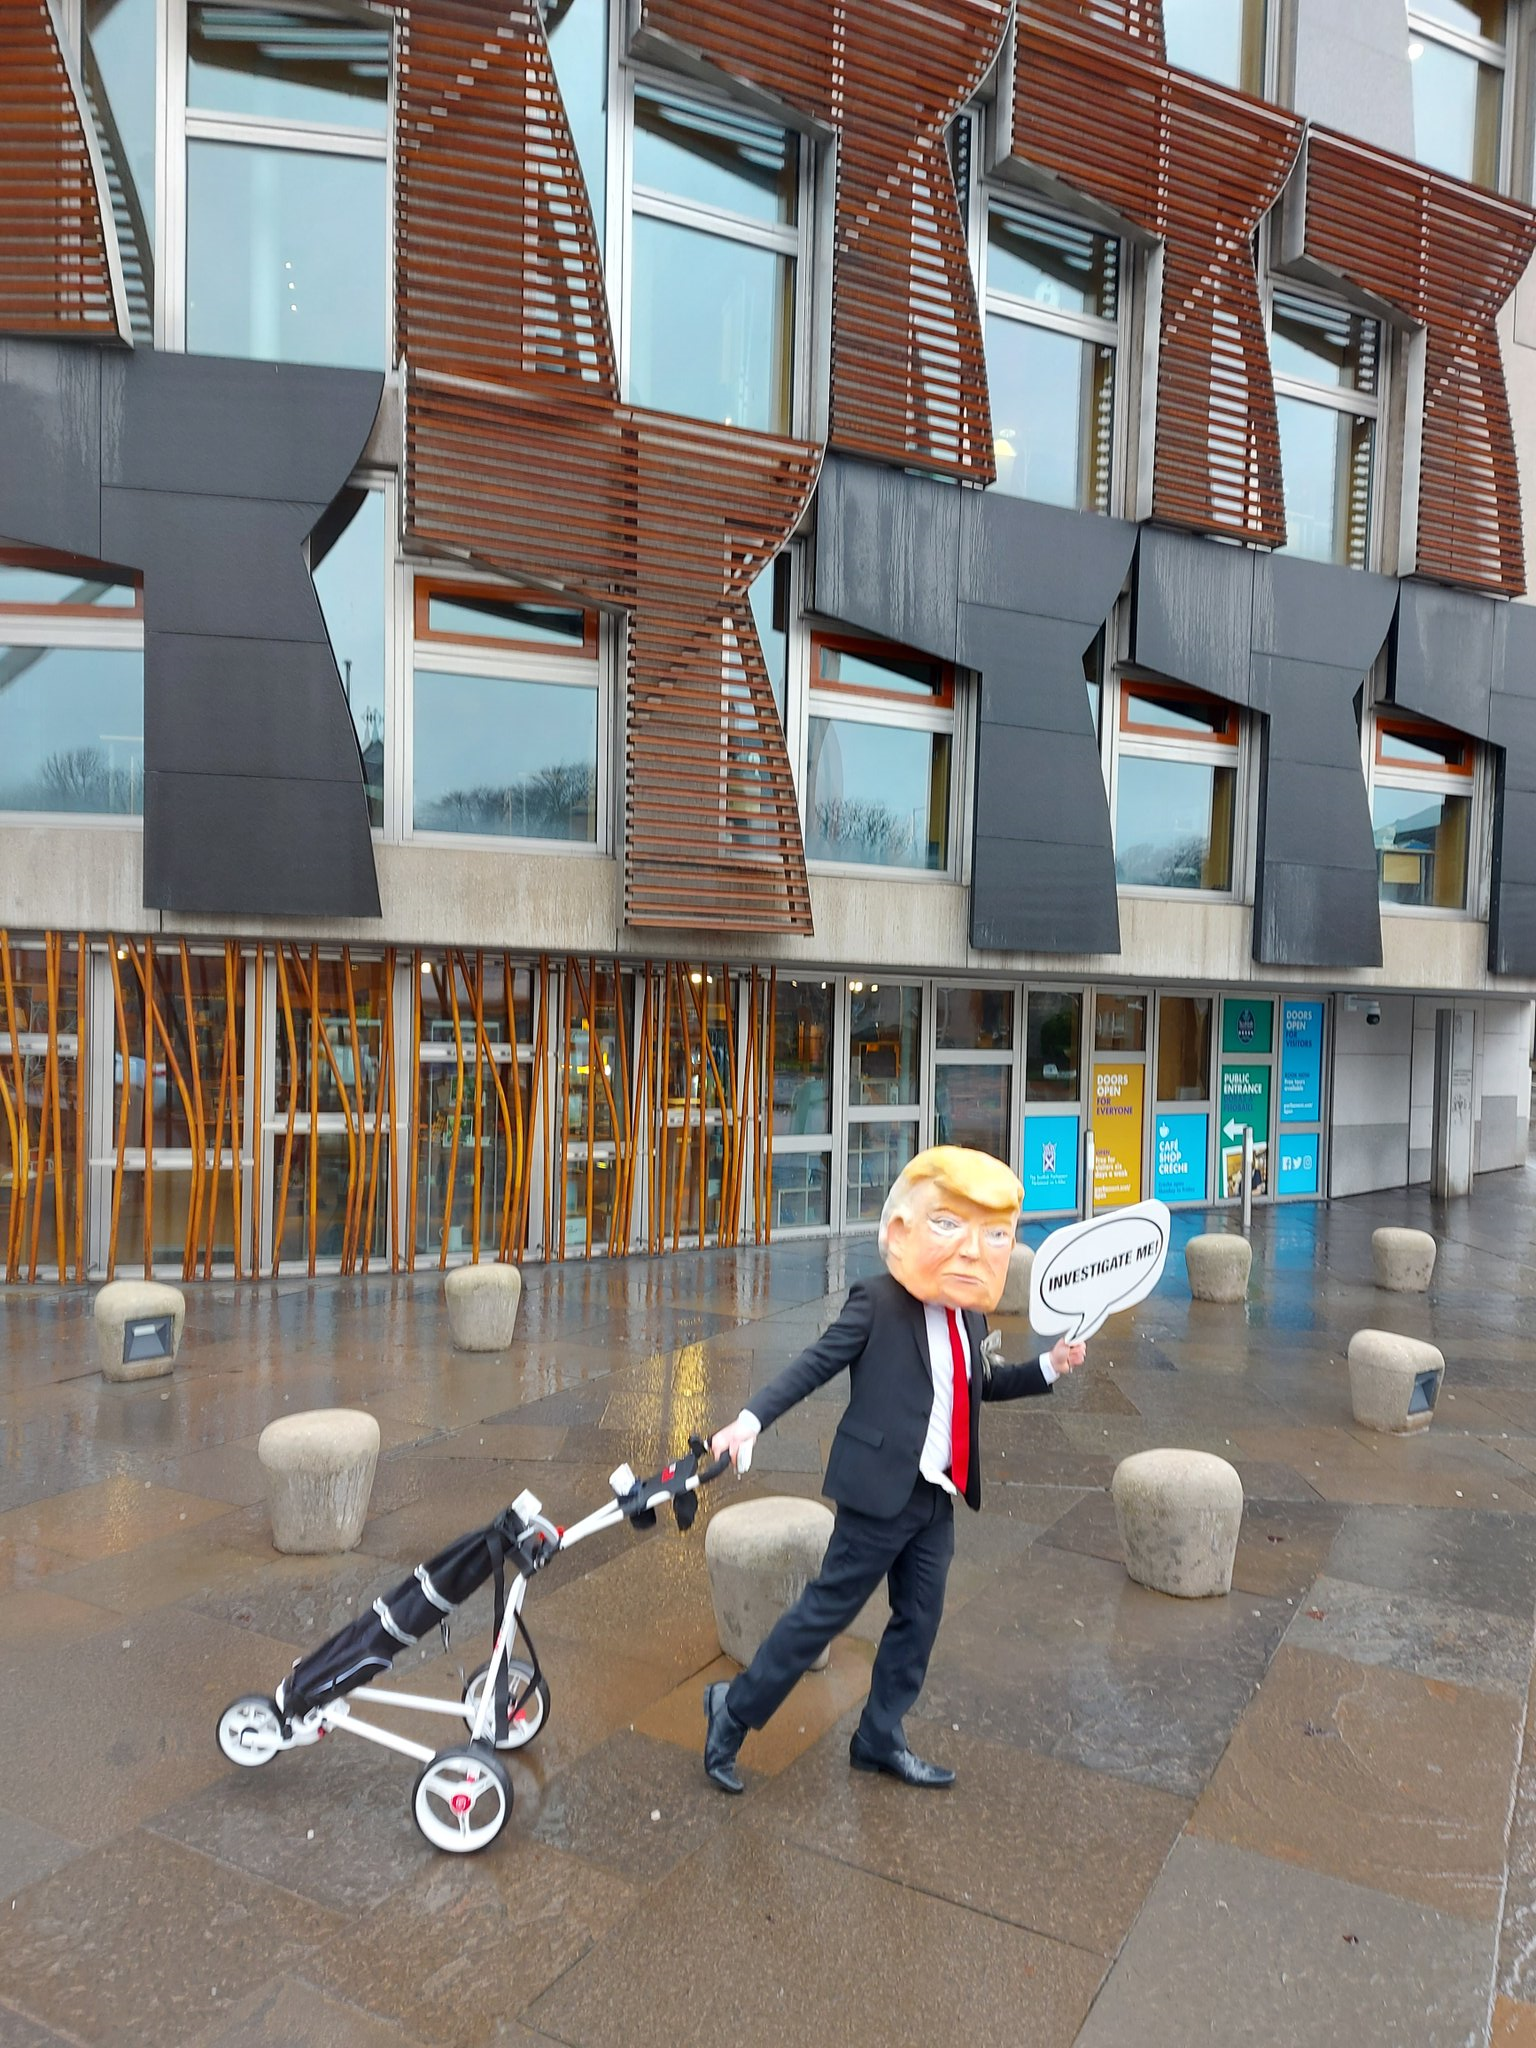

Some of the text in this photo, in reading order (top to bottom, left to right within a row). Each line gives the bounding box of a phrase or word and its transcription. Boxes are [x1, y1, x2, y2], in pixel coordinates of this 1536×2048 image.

[1286, 1010, 1312, 1020] DOORS
[1286, 1020, 1306, 1030] OPEN
[1286, 1030, 1297, 1038] FOR
[1286, 1040, 1312, 1048] VISITORS
[1097, 1074, 1129, 1086] DOORS
[1224, 1072, 1250, 1083] PUBLIC
[1097, 1085, 1121, 1097] OPEN
[1223, 1083, 1262, 1095] ENTRANCE
[1096, 1097, 1111, 1105] FOR
[1096, 1106, 1133, 1115] EVERYONE
[1159, 1138, 1179, 1151] CAFÉ
[1159, 1151, 1182, 1163] SHOP
[1049, 1239, 1159, 1292] INVESTIGATE ME!
